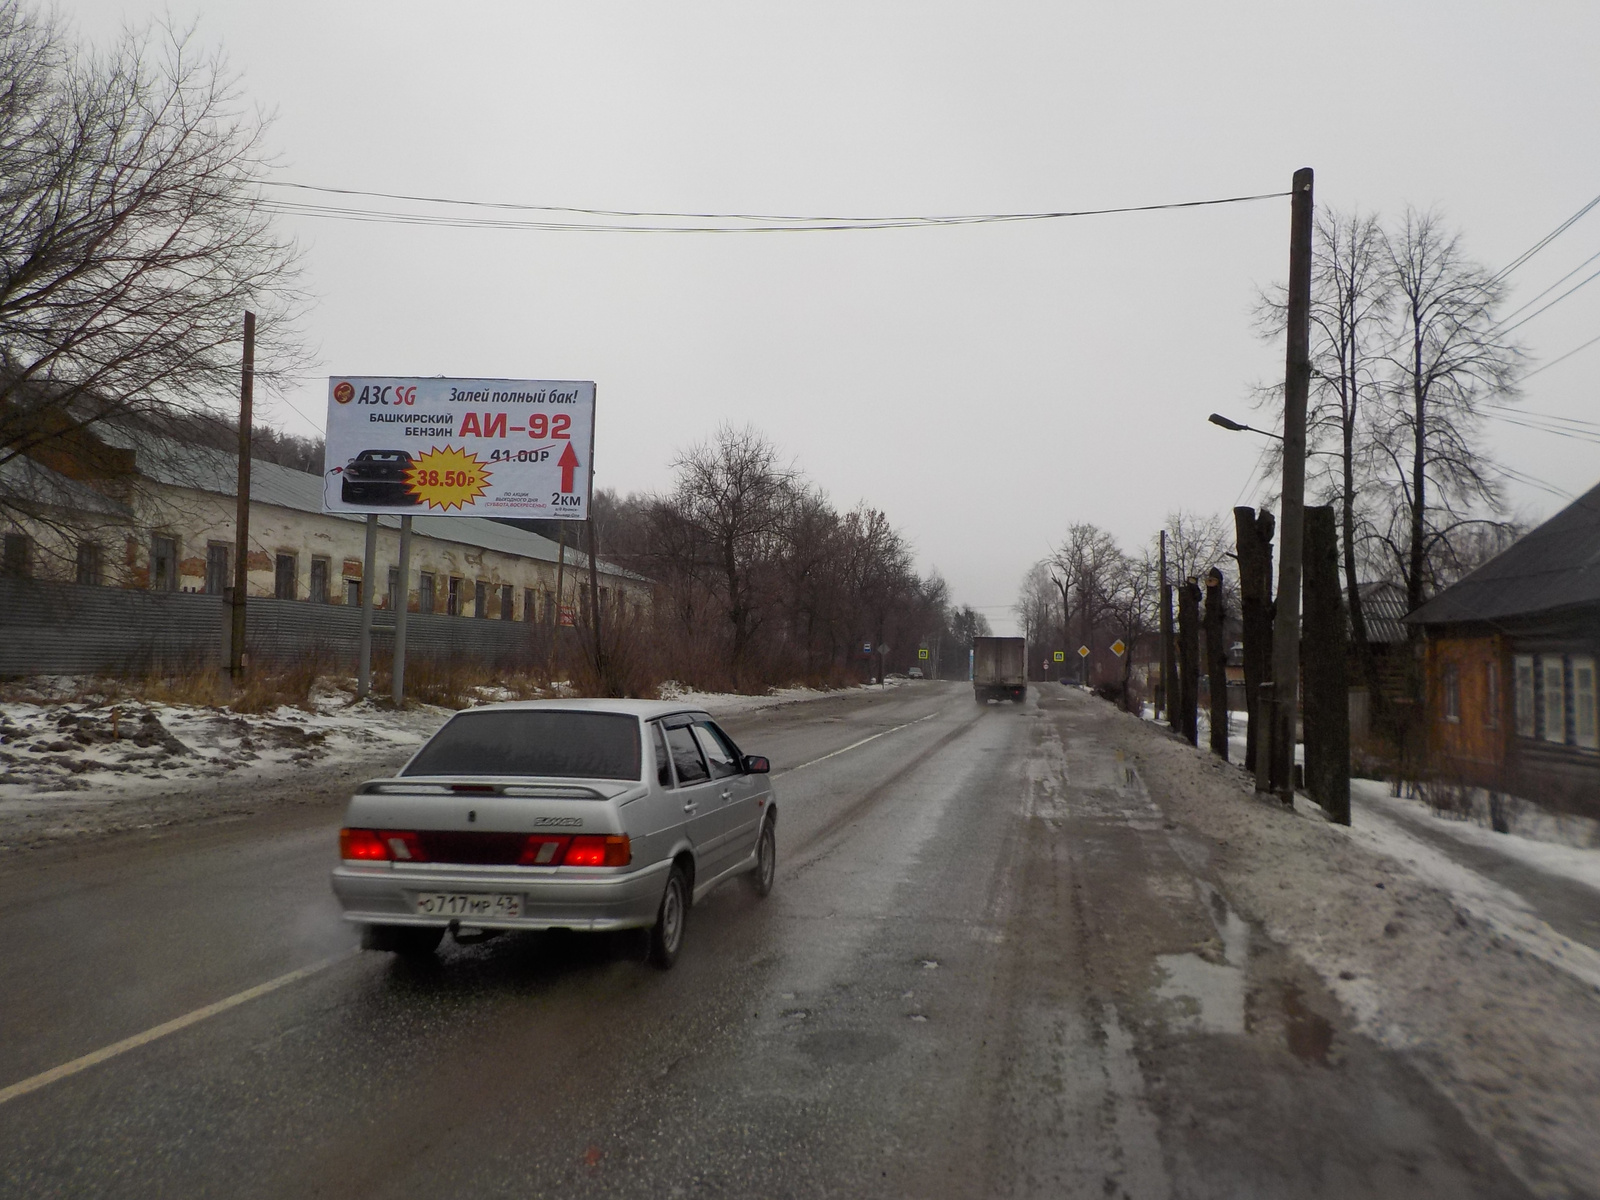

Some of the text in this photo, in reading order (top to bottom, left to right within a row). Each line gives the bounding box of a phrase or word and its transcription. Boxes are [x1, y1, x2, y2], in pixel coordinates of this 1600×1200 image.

[357, 385, 417, 405] АЗС SG
[449, 387, 579, 404] Залей полный бак!
[369, 412, 454, 424] БАШКИРСКИЙ
[458, 412, 572, 439] АИ-92
[405, 426, 453, 437] БЕНЗИН
